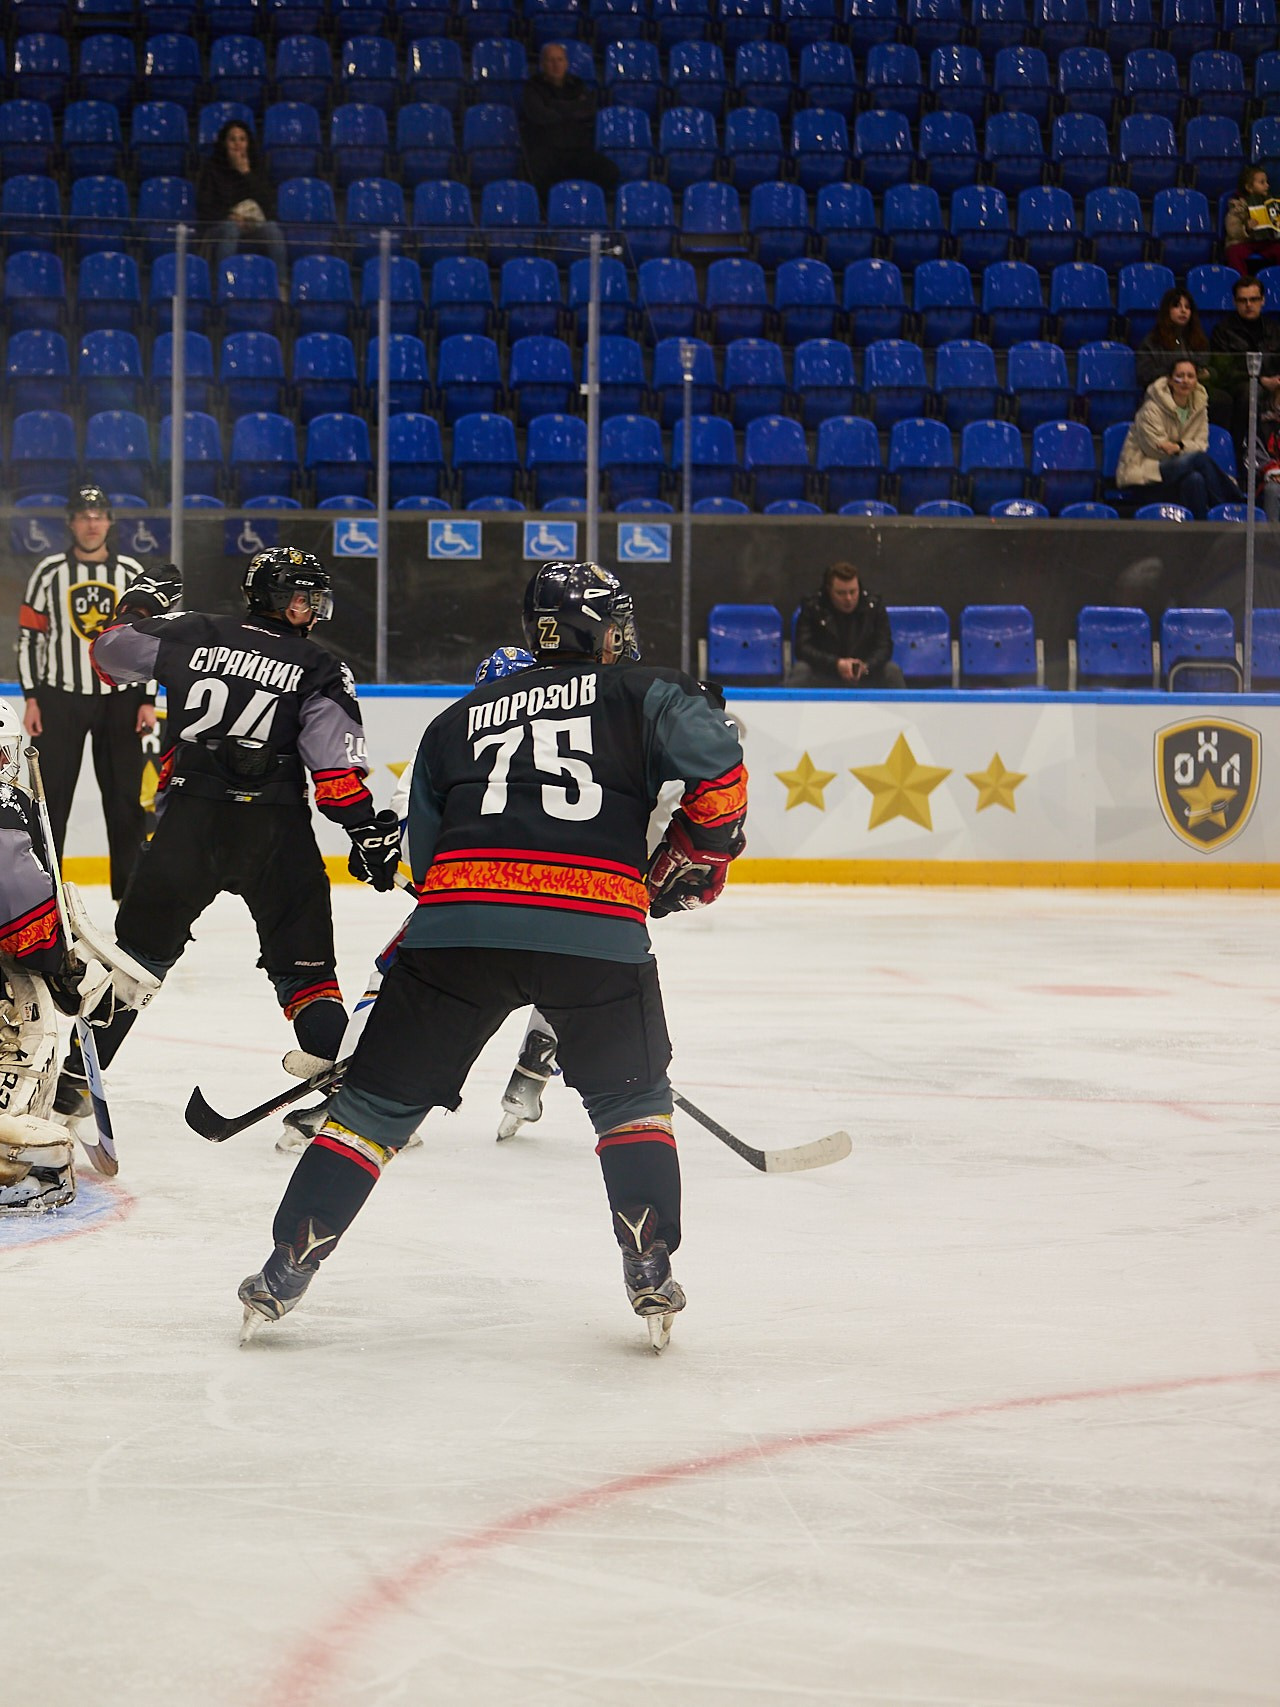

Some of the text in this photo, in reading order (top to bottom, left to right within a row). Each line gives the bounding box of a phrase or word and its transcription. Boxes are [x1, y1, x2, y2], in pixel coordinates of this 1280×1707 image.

[188, 645, 305, 694] СУРАЙКИН
[179, 677, 280, 744] 24
[473, 715, 603, 822] 75
